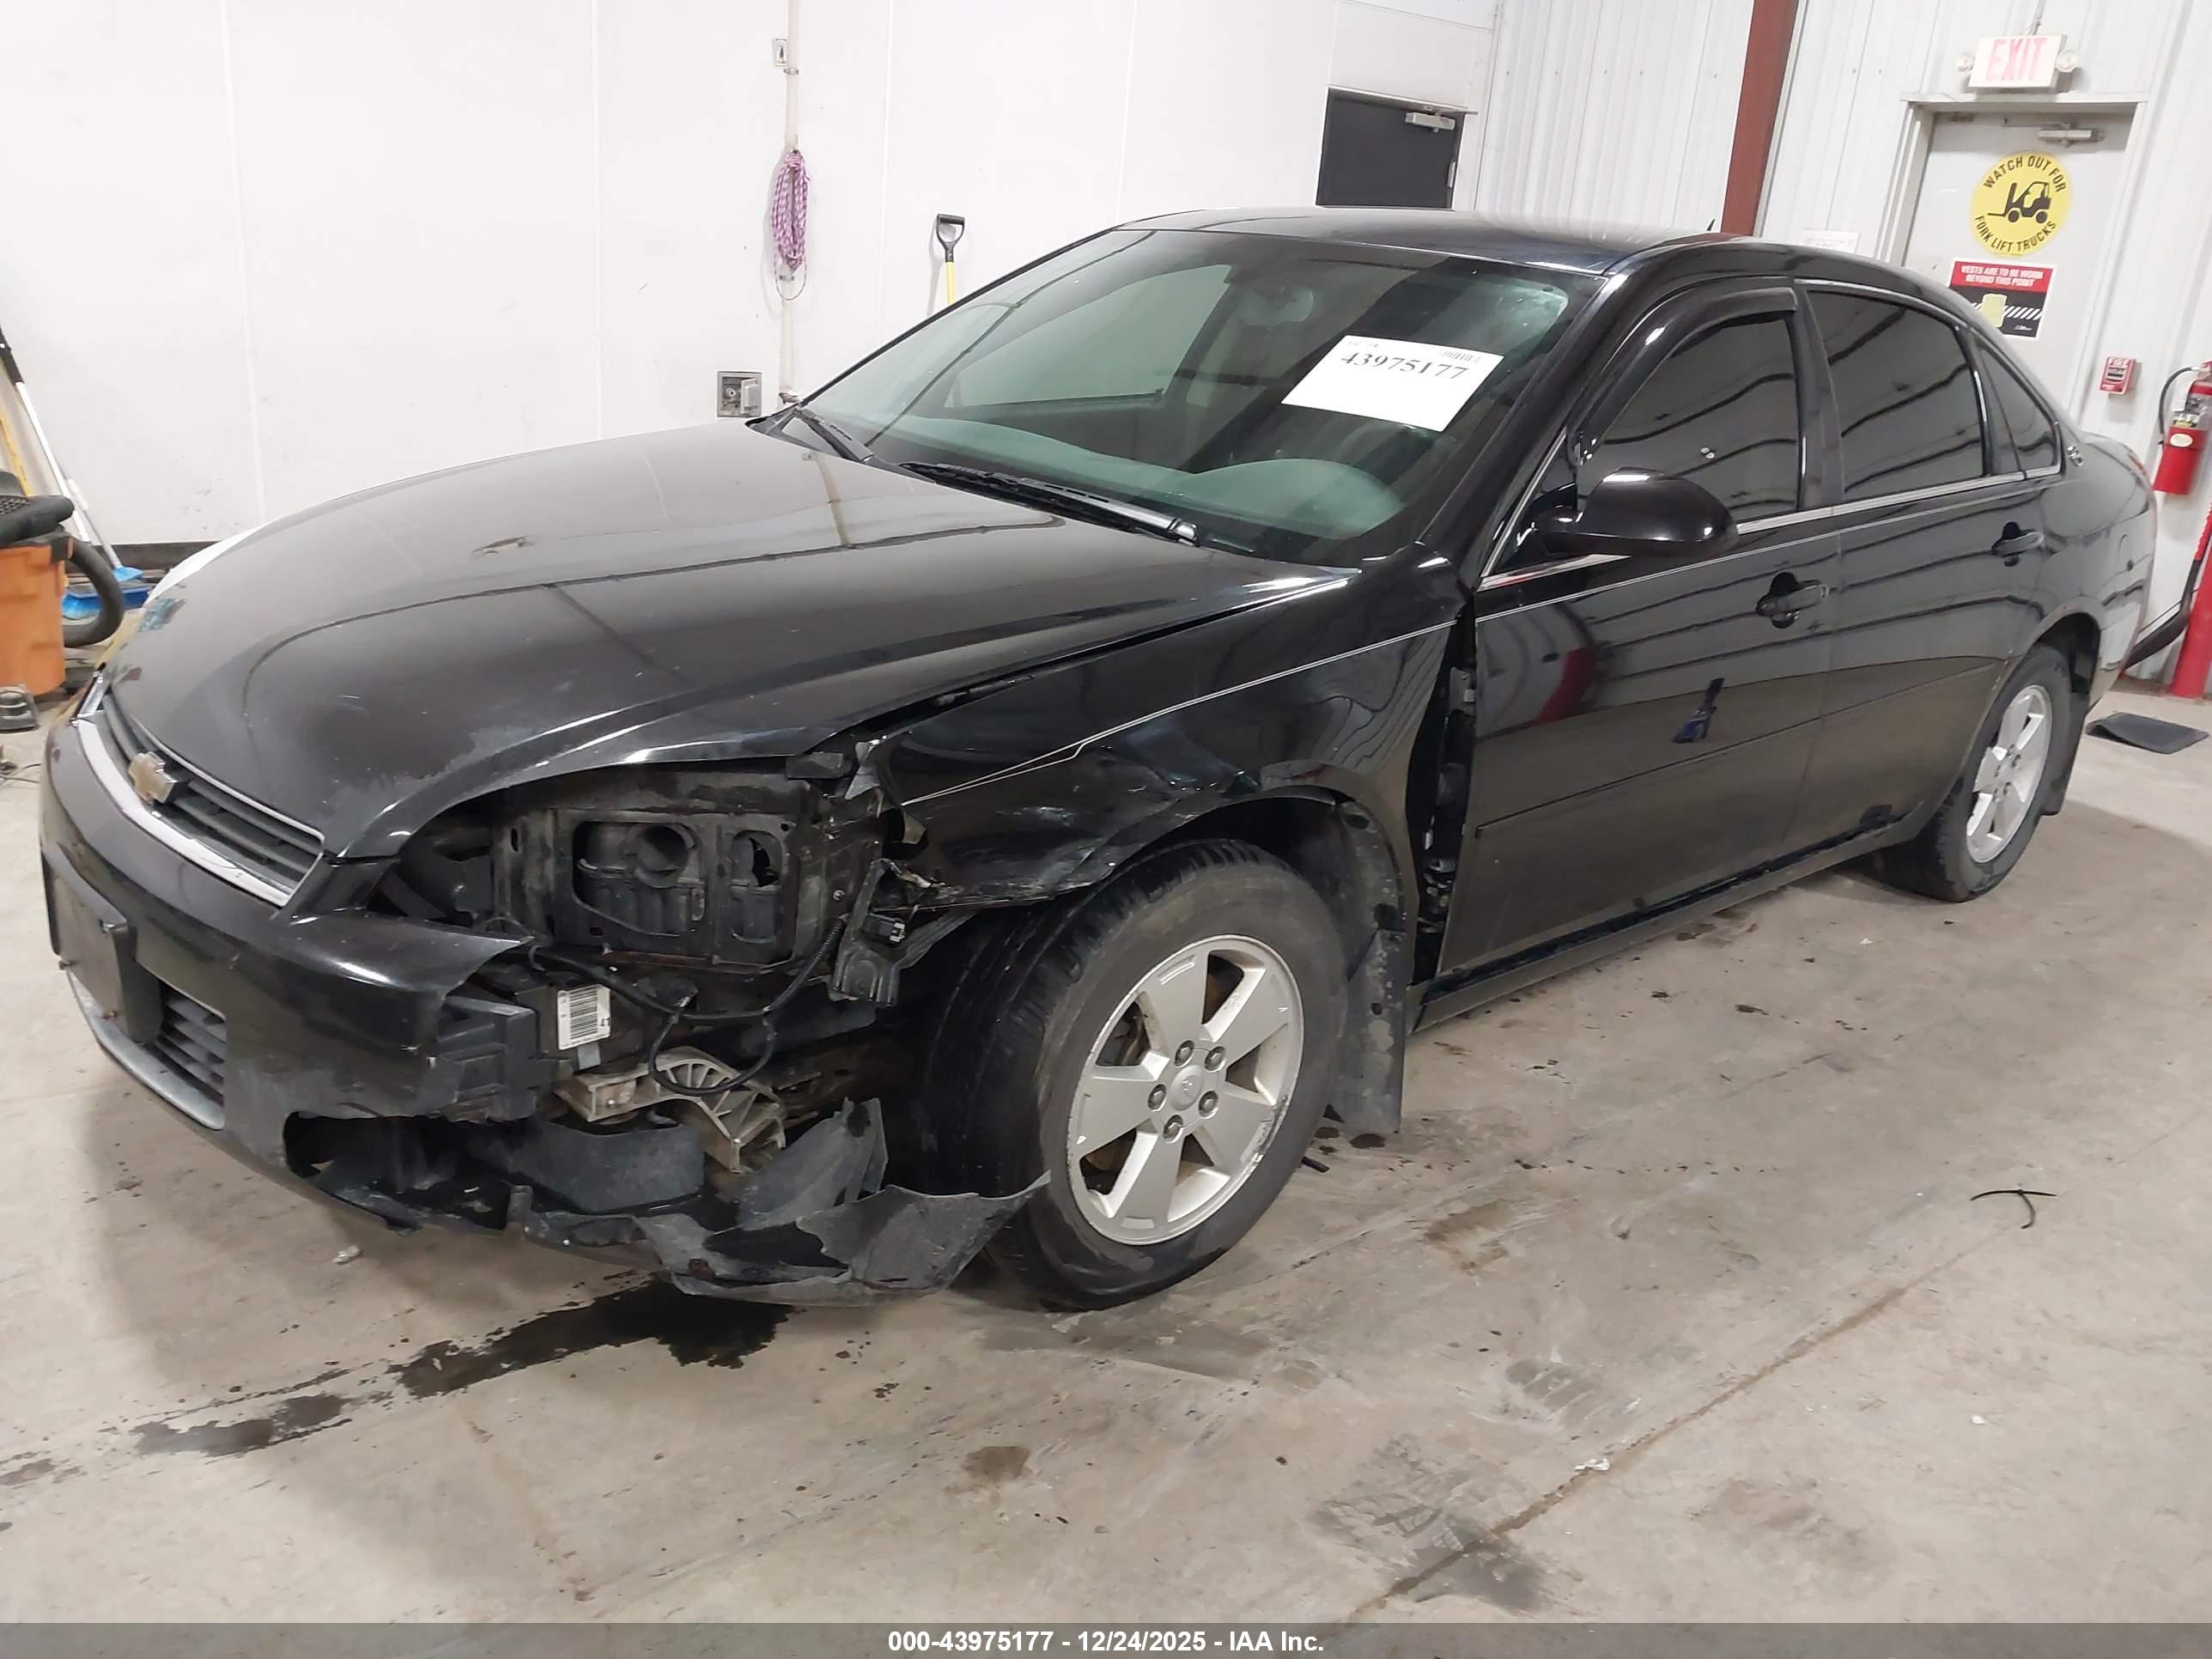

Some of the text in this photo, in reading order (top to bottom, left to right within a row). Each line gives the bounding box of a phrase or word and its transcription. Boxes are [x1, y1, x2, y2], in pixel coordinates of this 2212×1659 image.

[1984, 38, 2048, 82] EXIT
[1984, 155, 2067, 192] WATCH OUT FOR
[1975, 216, 2057, 252] FORK LIFT TRUCKS
[1960, 265, 1984, 275] VESTS
[1999, 268, 2009, 276] TO
[1341, 352, 1470, 380] 43975177
[2108, 357, 2130, 367] FIRE
